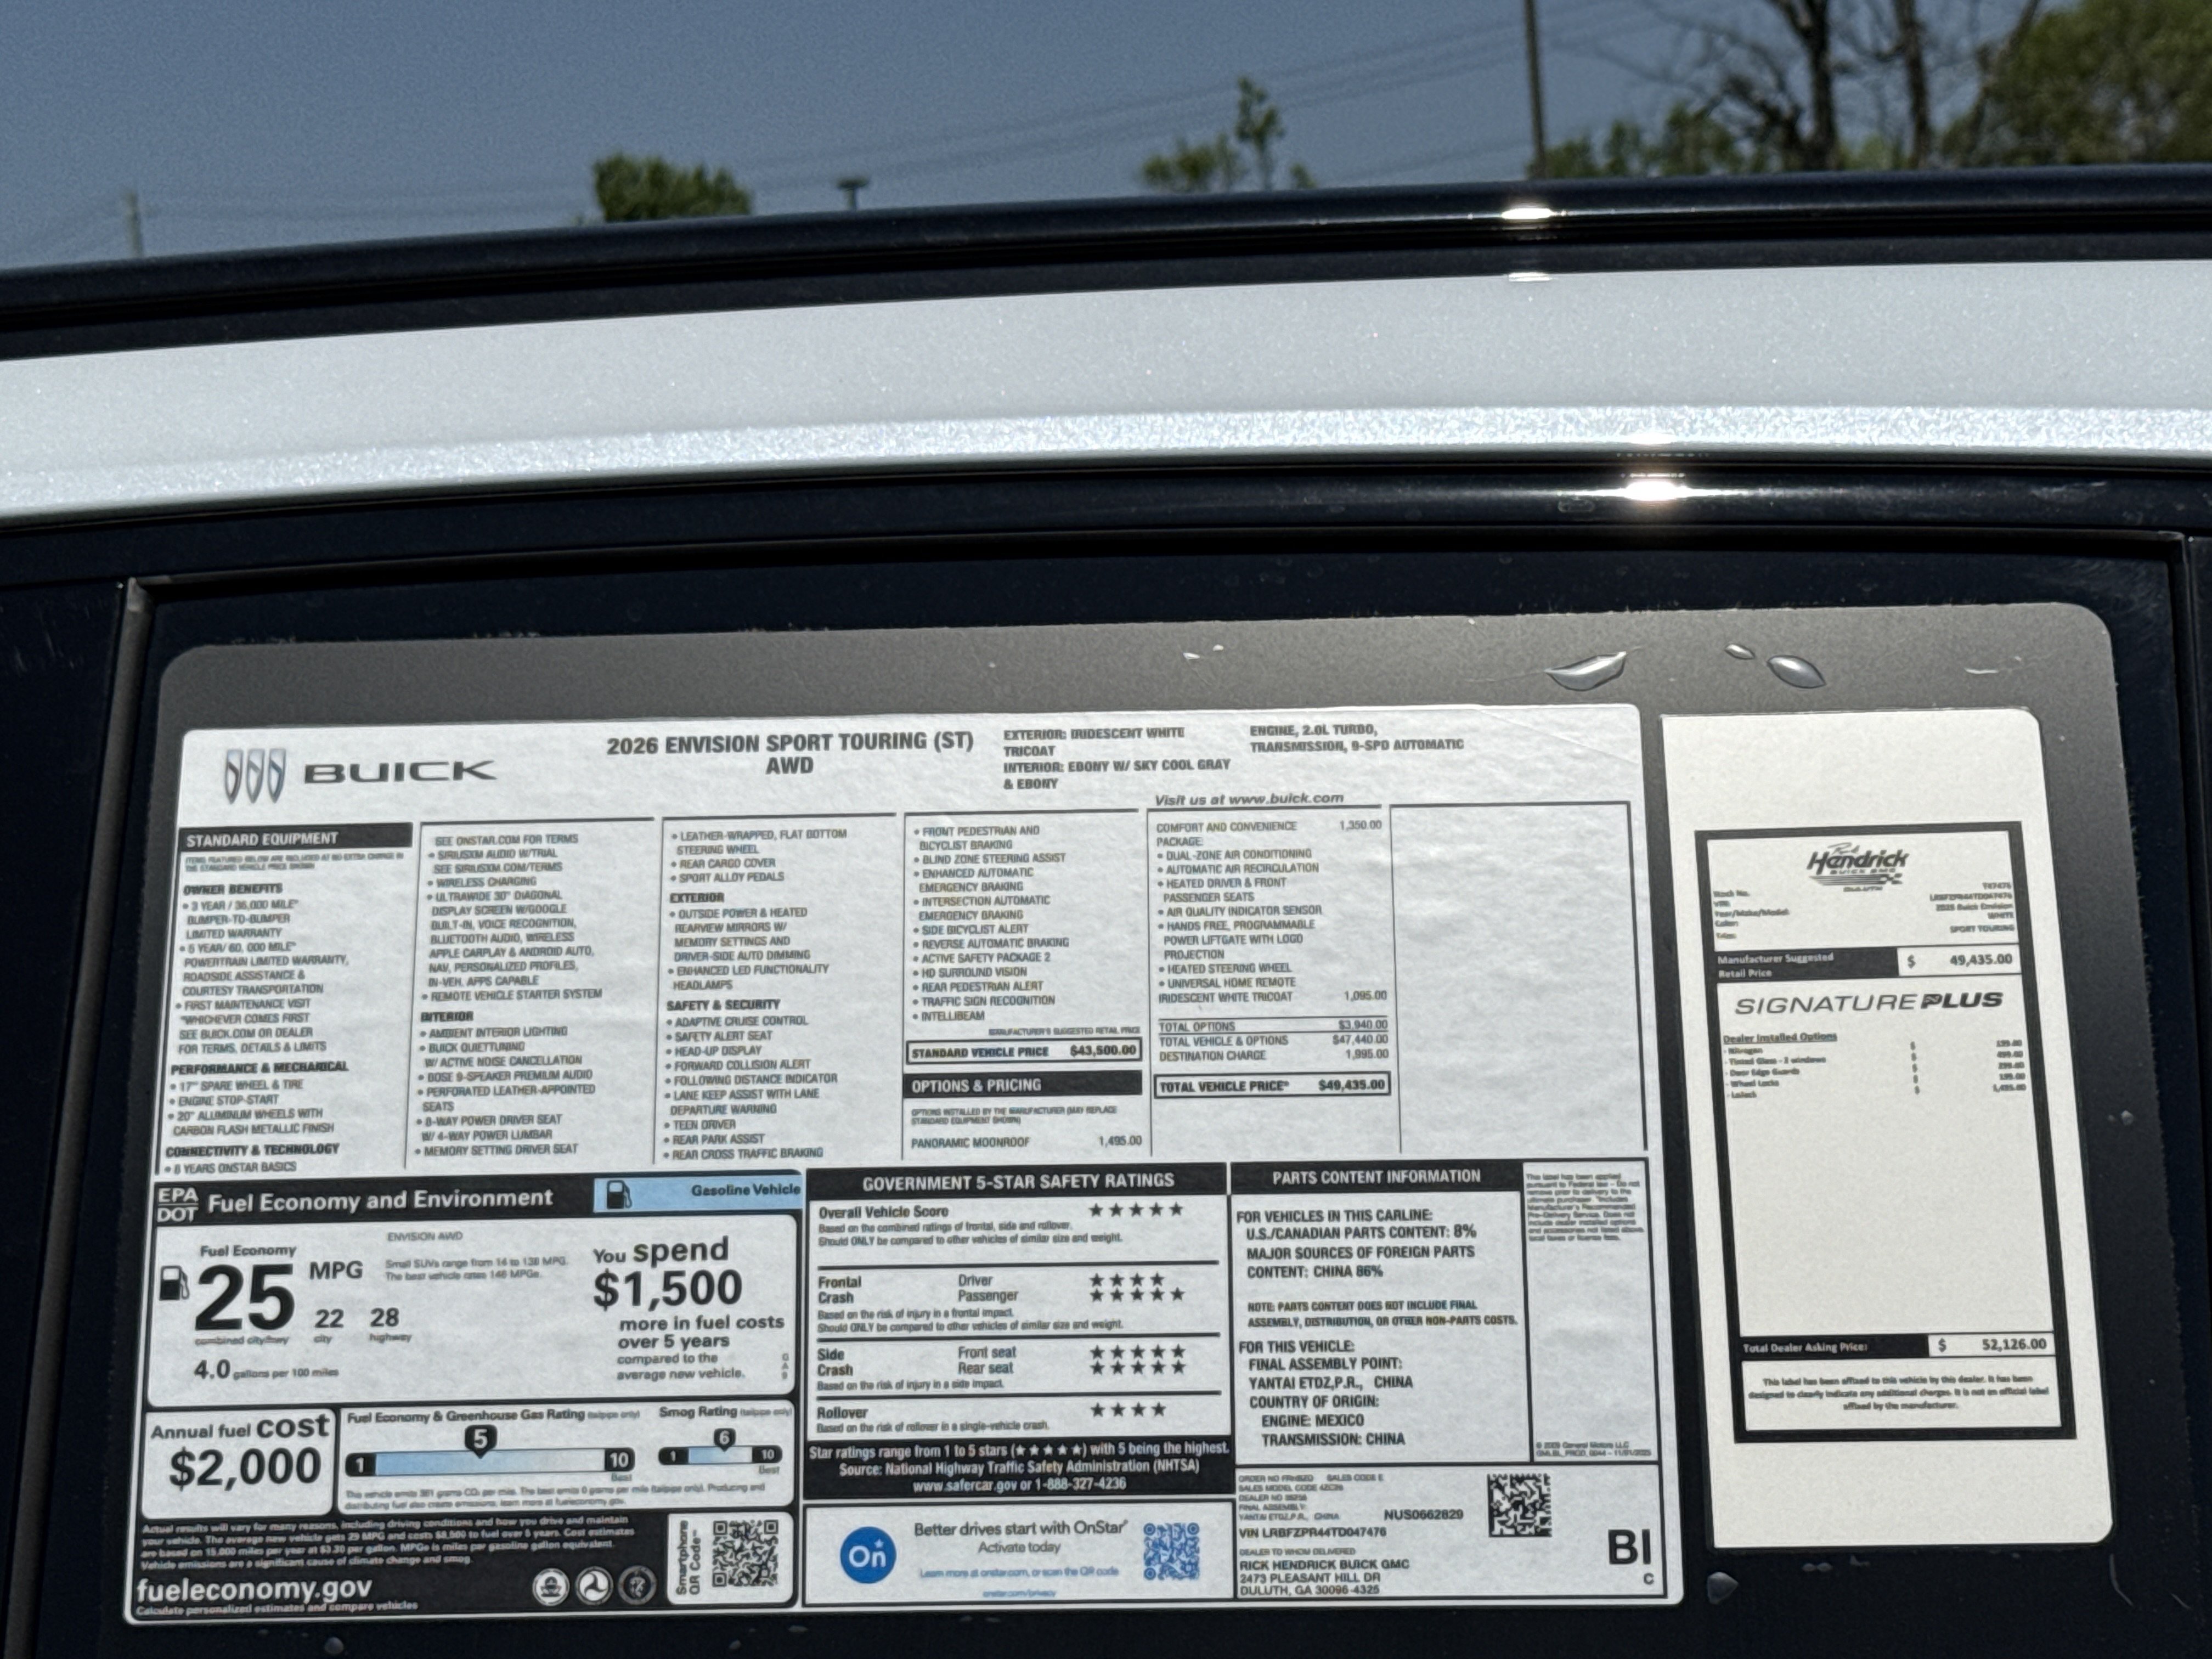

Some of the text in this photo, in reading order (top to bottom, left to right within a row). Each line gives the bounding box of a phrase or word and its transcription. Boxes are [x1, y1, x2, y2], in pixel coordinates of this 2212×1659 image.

[1004, 729, 1066, 741] EXTERIOR:
[1146, 727, 1184, 738] WHITE
[1250, 724, 1378, 738] ENGINE, 2.0L TURBO,
[607, 731, 973, 755] 2026 ENVISION SPORT TOURING (ST)
[1004, 746, 1056, 757] TRICOAT
[304, 760, 496, 784] BUICK
[766, 757, 813, 774] AWD
[1004, 759, 1231, 773] INTERIOR: EBONY W/ SKY COOL GRAY
[1155, 792, 1346, 806] Visit us at www.buick.com
[780, 830, 803, 839] FLAT
[806, 829, 847, 839] BOTTOM
[1156, 820, 1383, 833] COMFORT AND CONVENIENCE 1,350.00
[187, 832, 338, 847] STANDARD EQUIPMENT
[1166, 863, 1319, 874] AUTOMATIC AIR RECIRCULATION
[1806, 849, 1910, 874] Hendrick
[1718, 952, 1834, 964] Manufacturer Suggested
[1908, 953, 2012, 968] $ 49,435.00
[1719, 968, 1772, 978] Retail Price
[185, 998, 311, 1011] FIRST MAINTENANCE VISIT
[667, 999, 780, 1011] SAFETY & SECURITY
[1735, 992, 2003, 1014] SIGNATUREPLUS
[675, 1015, 809, 1028] ADAPTIVE CRUISE CONTROL
[912, 1043, 1137, 1059] STANDARD VEHICLE PRICE $43,500.00
[912, 1079, 1041, 1093] OPTIONS & PRICING
[1160, 1082, 1195, 1093] TOTAL
[1199, 1081, 1246, 1092] VEHICLE
[1318, 1079, 1385, 1093] $49,435.00
[911, 1135, 1142, 1149] PANORAMIC MOONROOF 1,495.00
[864, 1173, 1175, 1191] GOVERNMENT 5-STAR SAFETY RATINGS
[1273, 1169, 1480, 1185] PARTS CONTENT INFORMATION
[158, 1187, 199, 1203] EPA
[691, 1182, 801, 1197] Gasoline Vehicle
[208, 1188, 553, 1215] Fuel Economy and Environment
[157, 1208, 199, 1222] DOT
[819, 1205, 949, 1219] Overall Vehicle Score
[200, 1244, 297, 1259] Fuel Economy
[594, 1235, 728, 1265] You spend
[1247, 1245, 1475, 1260] MAJOR SOURCES OF FOREIGN PARTS
[310, 1261, 363, 1280] MPG
[959, 1273, 993, 1287] Driver
[195, 1263, 295, 1331] 25
[593, 1268, 742, 1312] $1,500
[958, 1289, 1019, 1304] Passenger
[314, 1309, 344, 1328] 22
[370, 1308, 399, 1327] 28
[620, 1315, 785, 1331] more in fuel costs
[618, 1334, 730, 1350] over 5 years
[1743, 1338, 2047, 1353] Total Dealer Asking Price: $ 52,126.00
[958, 1346, 1017, 1359] Front seat
[194, 1359, 230, 1379] 4.0
[958, 1361, 1014, 1375] Rear seat
[1250, 1395, 1379, 1408] COUNTRY OF ORIGIN:
[659, 1406, 695, 1420] Smog
[698, 1406, 737, 1418] Rating
[817, 1406, 868, 1419] Rollover
[151, 1412, 332, 1440] Annual fuel cost
[1262, 1414, 1364, 1427] ENGINE: MEXICO
[474, 1429, 487, 1448] 5
[716, 1429, 730, 1446] 6
[1262, 1432, 1406, 1446] TRANSMISSION: CHINA
[611, 1452, 628, 1468] 10
[839, 1458, 1199, 1477] Source: National Highway Traffic Safety Administration (NHTSA)
[170, 1445, 321, 1492] $2,000
[849, 1541, 885, 1567] On
[1609, 1529, 1651, 1564] BI
[1240, 1559, 1409, 1571] RICK HENDRICK BUICK GMC
[137, 1576, 371, 1604] fueleconomy.gov
